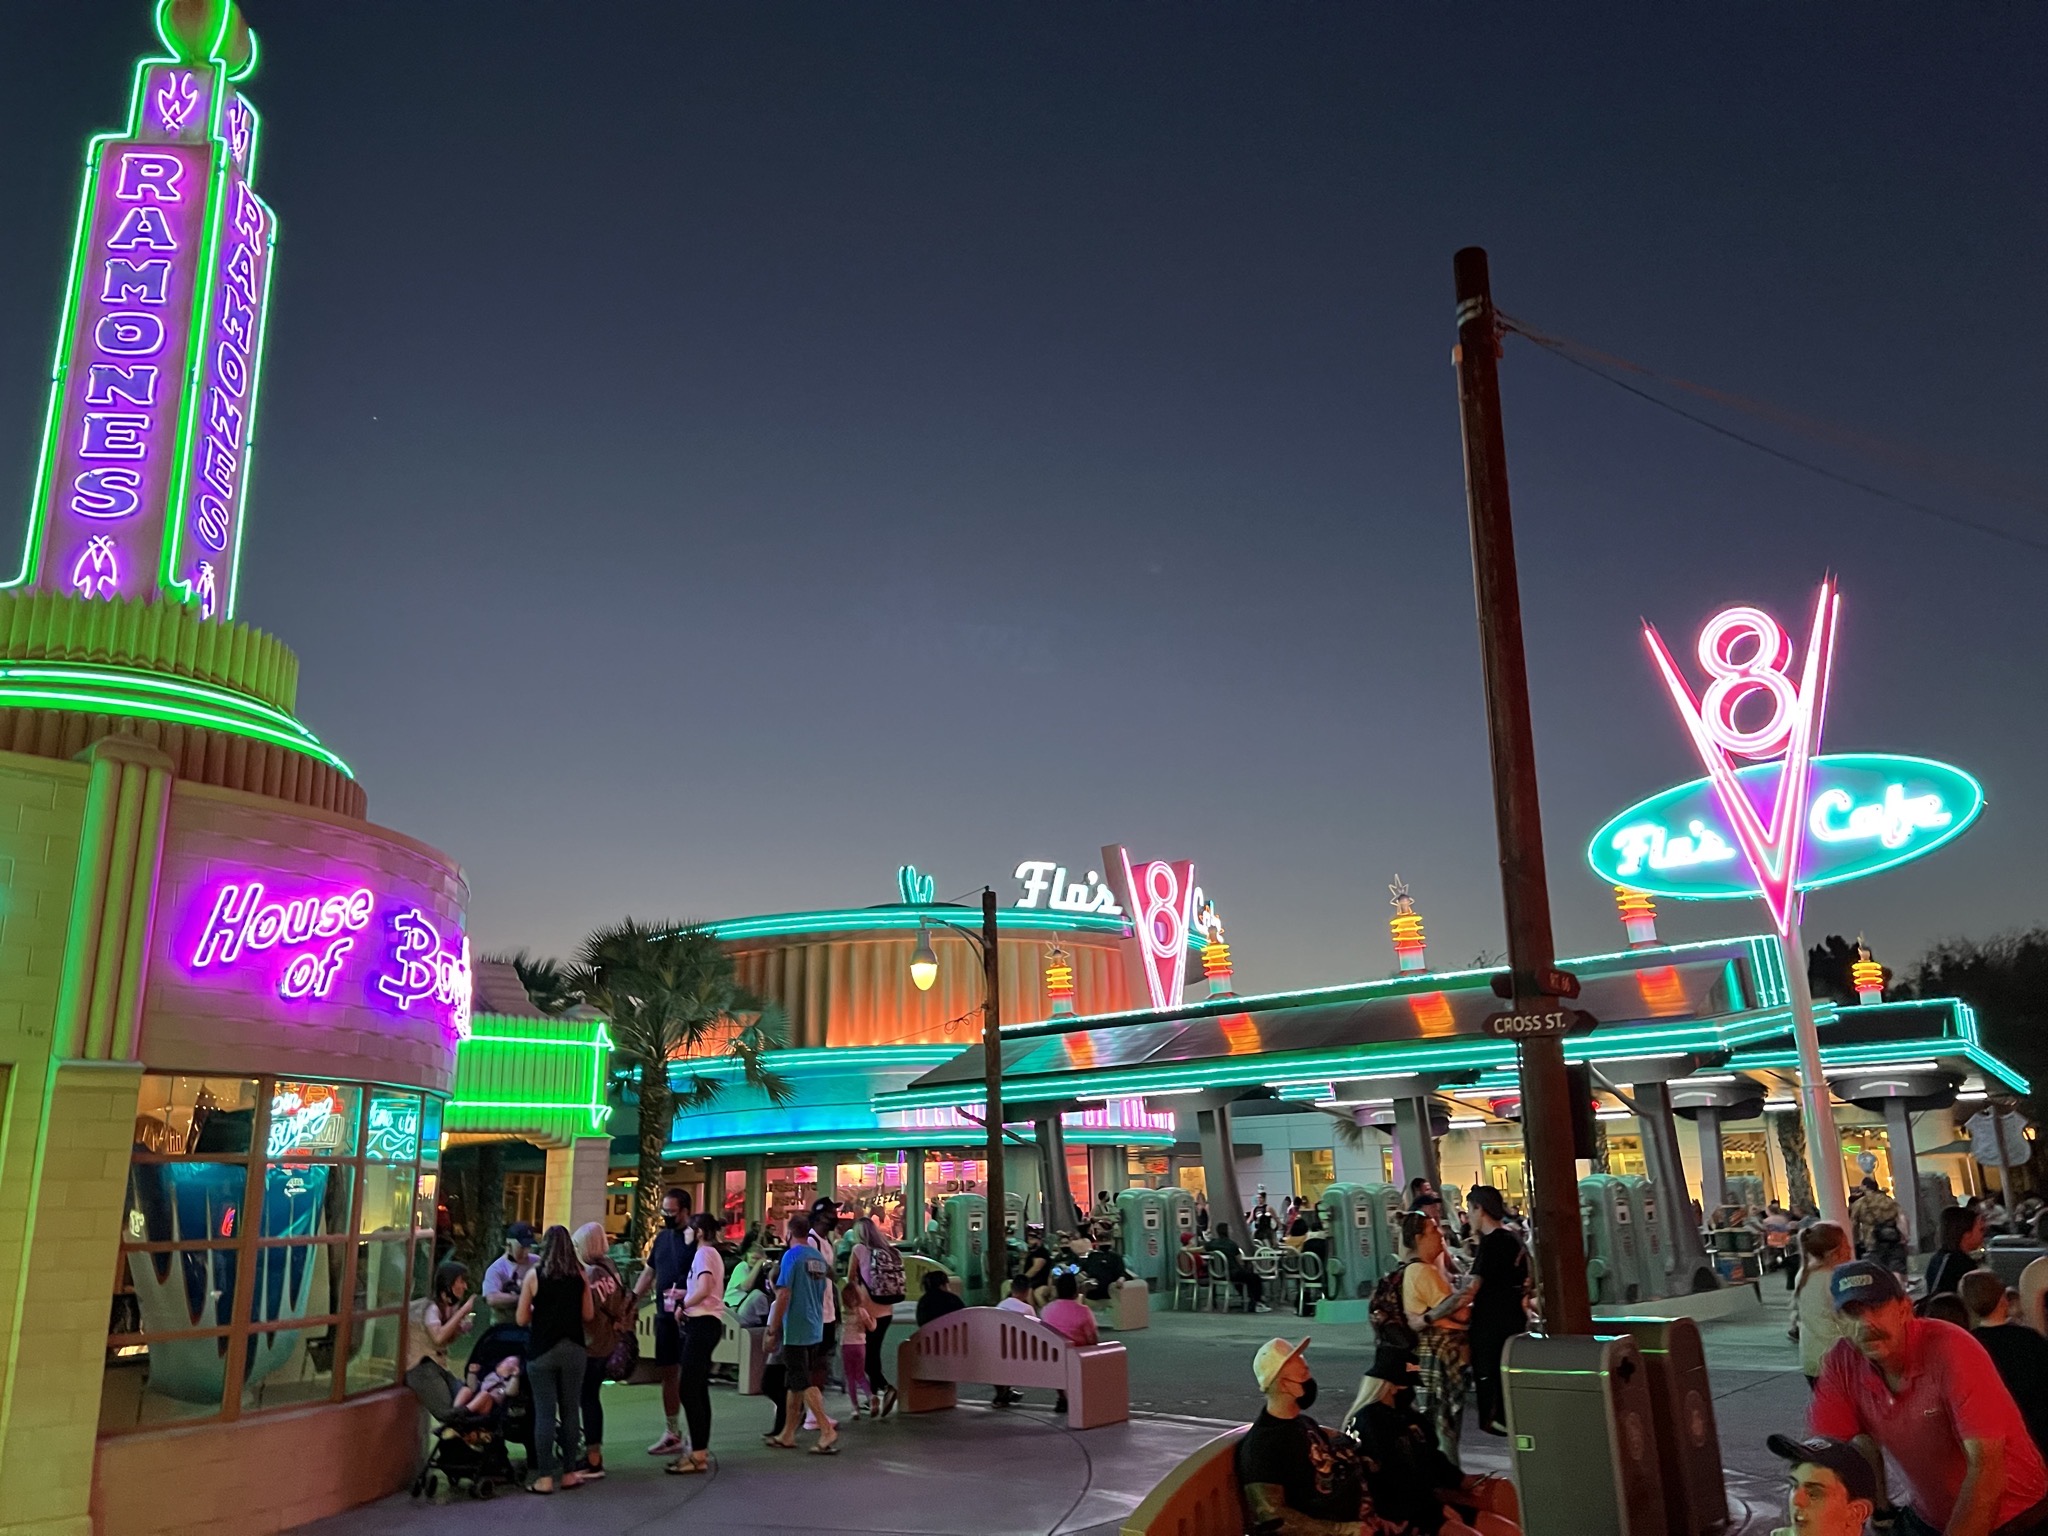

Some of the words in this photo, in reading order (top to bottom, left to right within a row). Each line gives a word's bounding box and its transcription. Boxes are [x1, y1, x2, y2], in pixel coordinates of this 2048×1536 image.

[71, 153, 182, 519] RAMONES
[198, 180, 264, 553] RAMONES
[1612, 821, 1736, 876] Flo's
[1809, 783, 1952, 849] Cafe
[1014, 860, 1124, 915] Flo's
[192, 882, 375, 968] House
[281, 937, 354, 1000] of
[1494, 1015, 1542, 1034] CROSS
[1545, 1012, 1567, 1030] ST.
[946, 1180, 976, 1192] DIP
